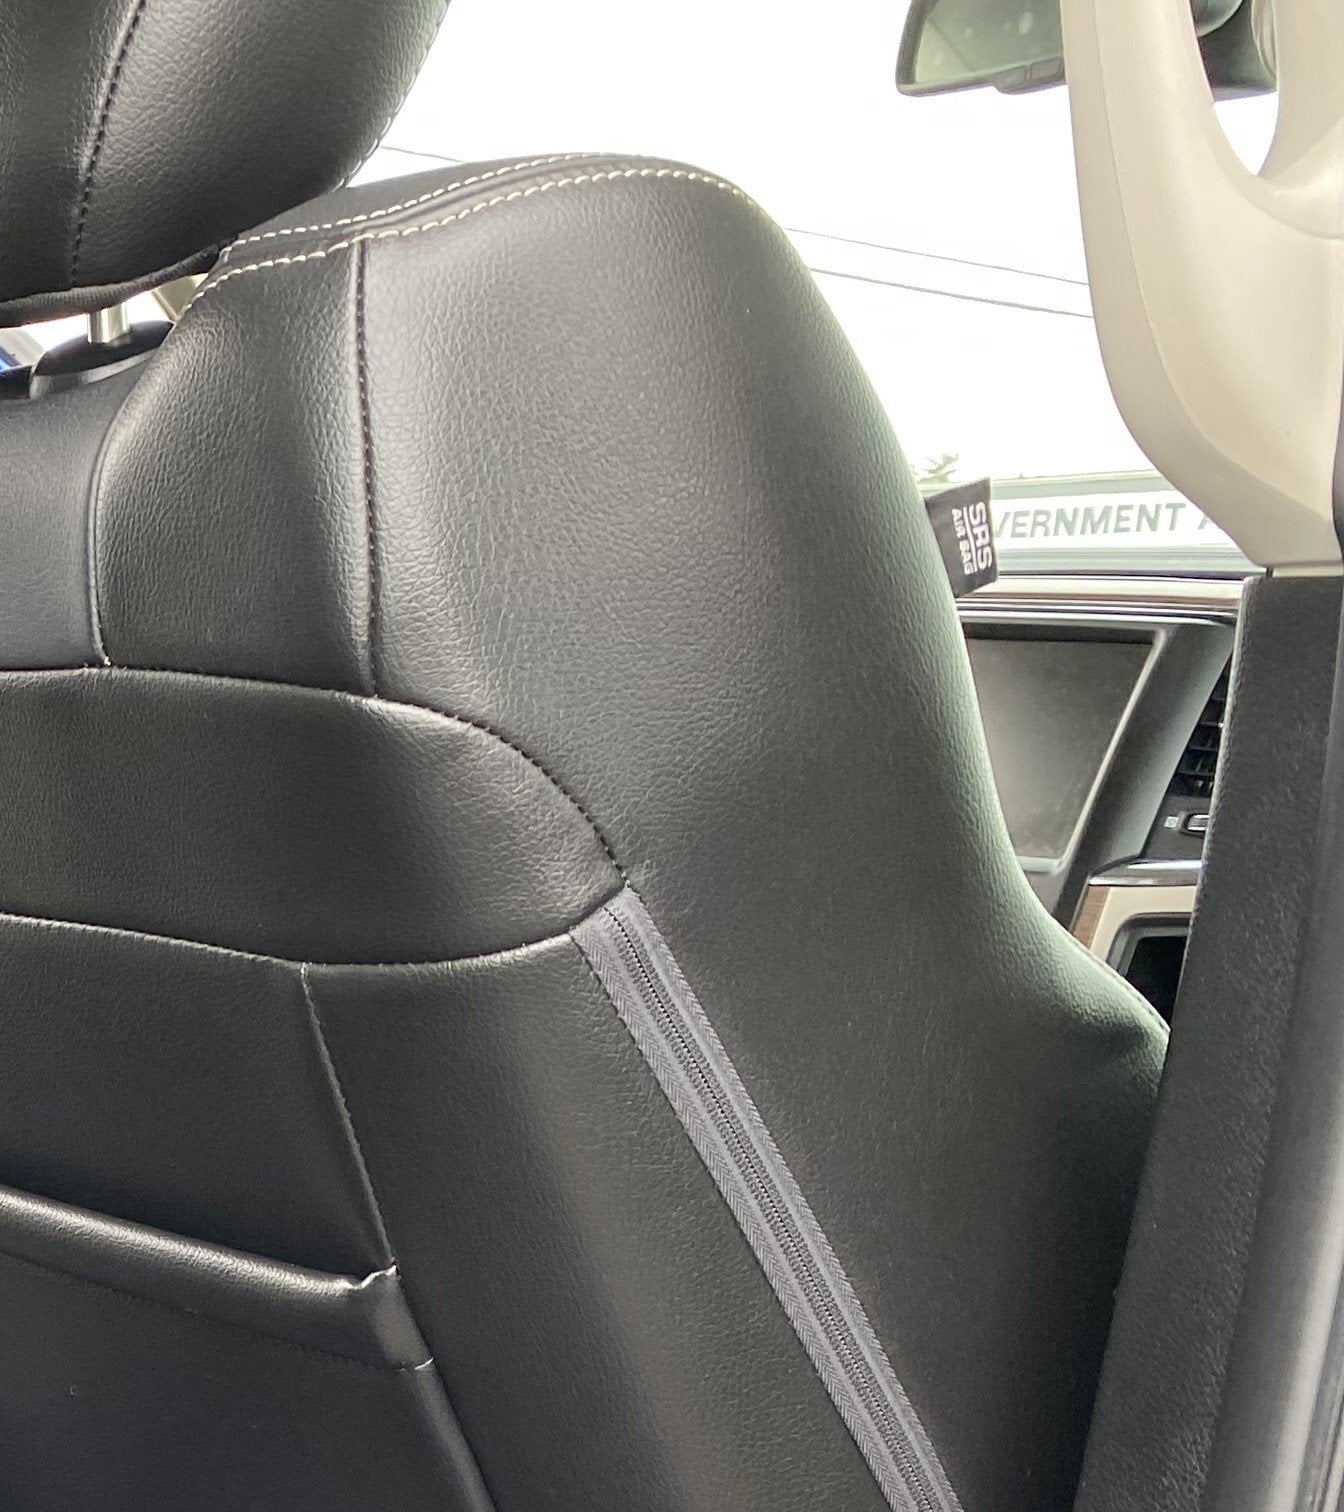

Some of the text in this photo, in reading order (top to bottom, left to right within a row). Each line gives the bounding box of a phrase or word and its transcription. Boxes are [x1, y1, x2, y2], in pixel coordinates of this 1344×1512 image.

[951, 508, 974, 575] AIR BAG
[968, 501, 994, 571] SRS
